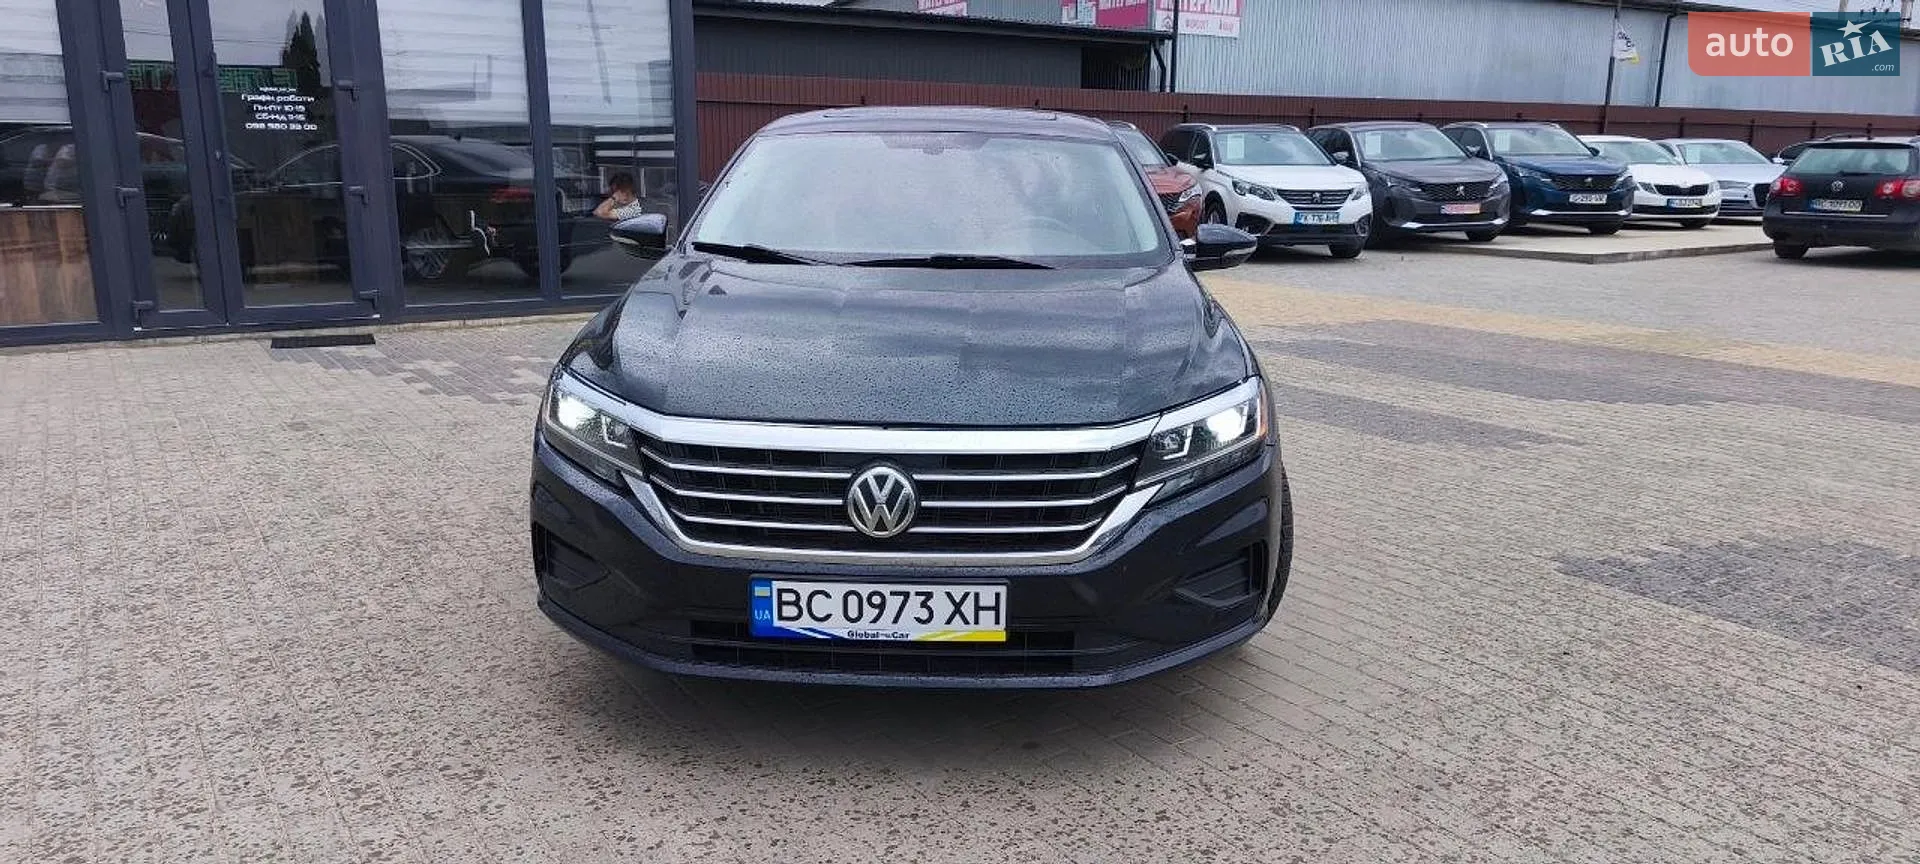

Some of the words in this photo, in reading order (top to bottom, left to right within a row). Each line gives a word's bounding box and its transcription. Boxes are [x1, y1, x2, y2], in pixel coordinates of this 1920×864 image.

[754, 609, 771, 621] UA
[776, 588, 833, 623] BC
[842, 589, 935, 625] 0973
[944, 591, 1001, 626] XH
